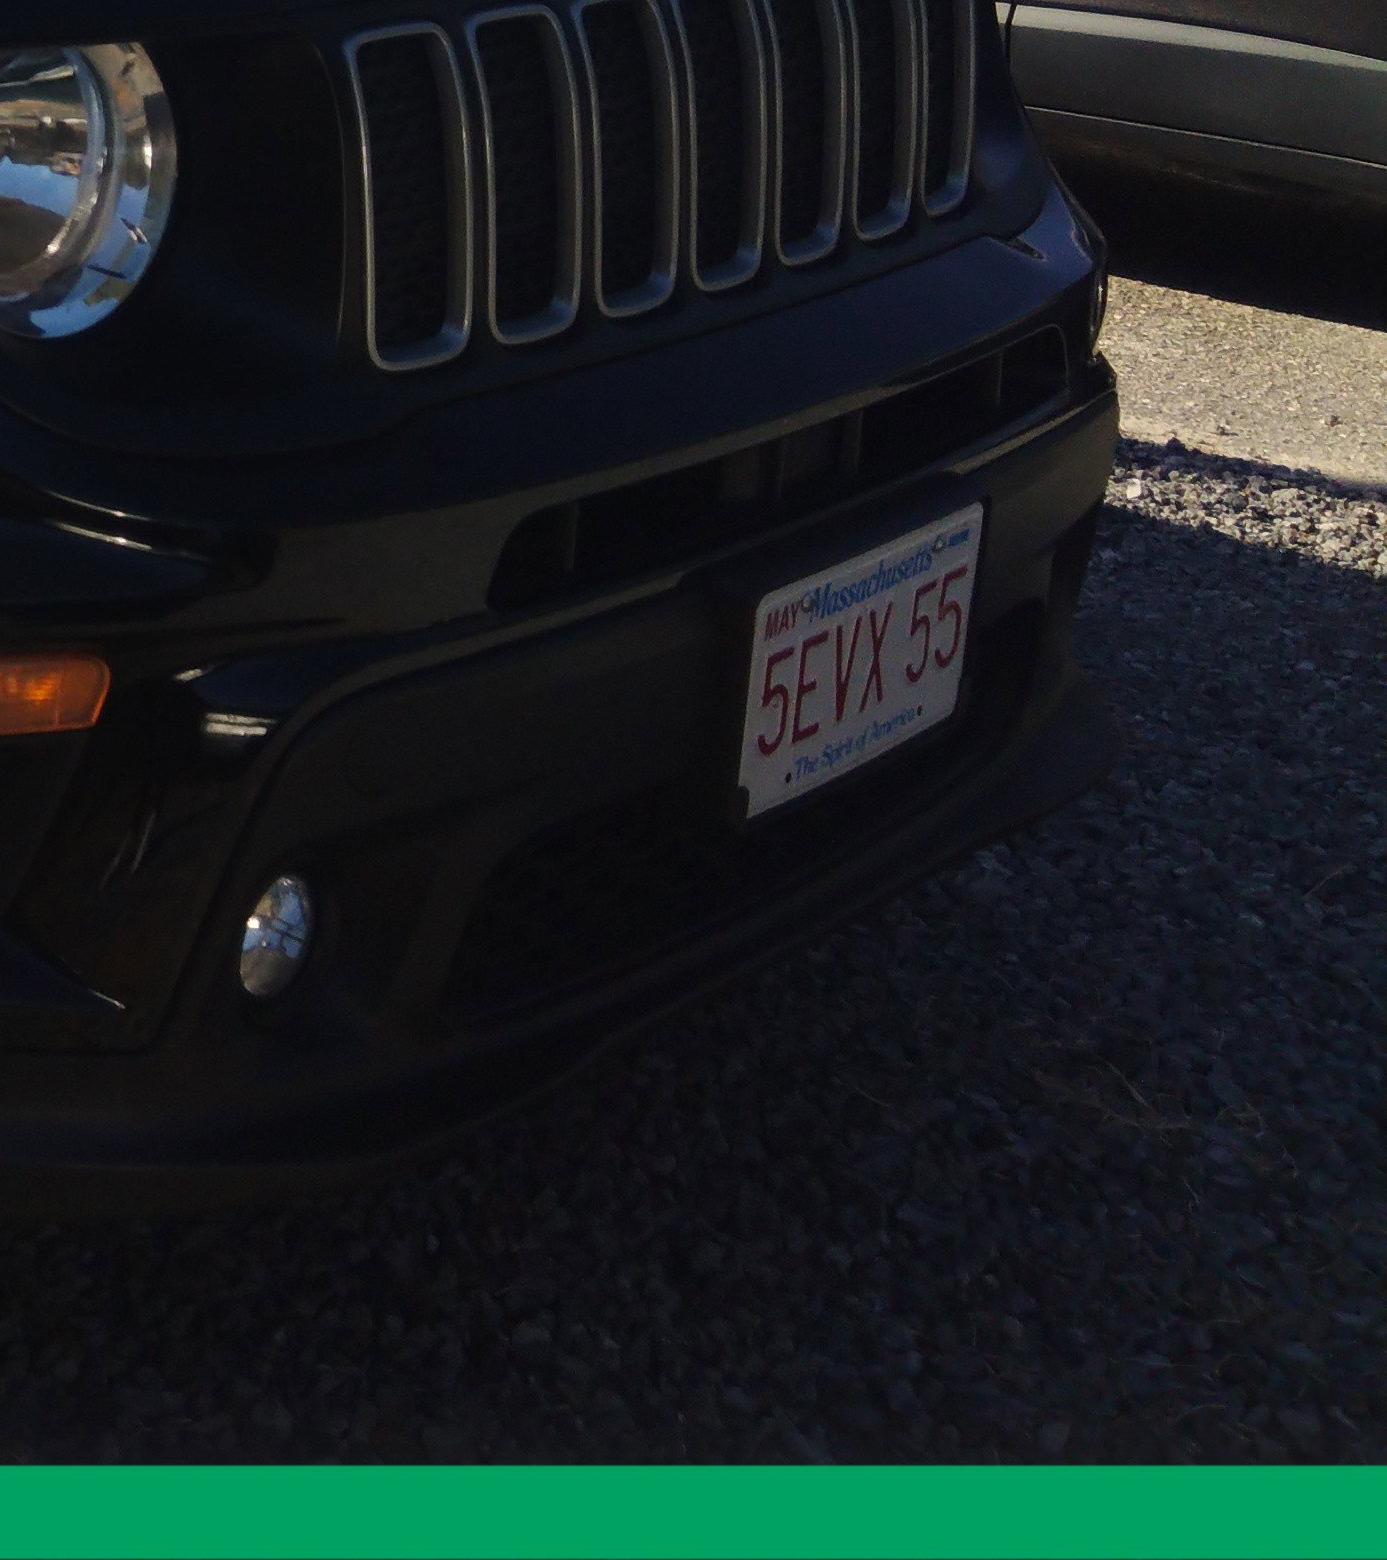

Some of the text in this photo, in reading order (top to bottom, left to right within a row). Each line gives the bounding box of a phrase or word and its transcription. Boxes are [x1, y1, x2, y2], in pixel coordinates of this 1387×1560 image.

[764, 549, 934, 641] MAY Massachusetts
[757, 565, 969, 757] 5EVX 55
[794, 755, 815, 781] The
